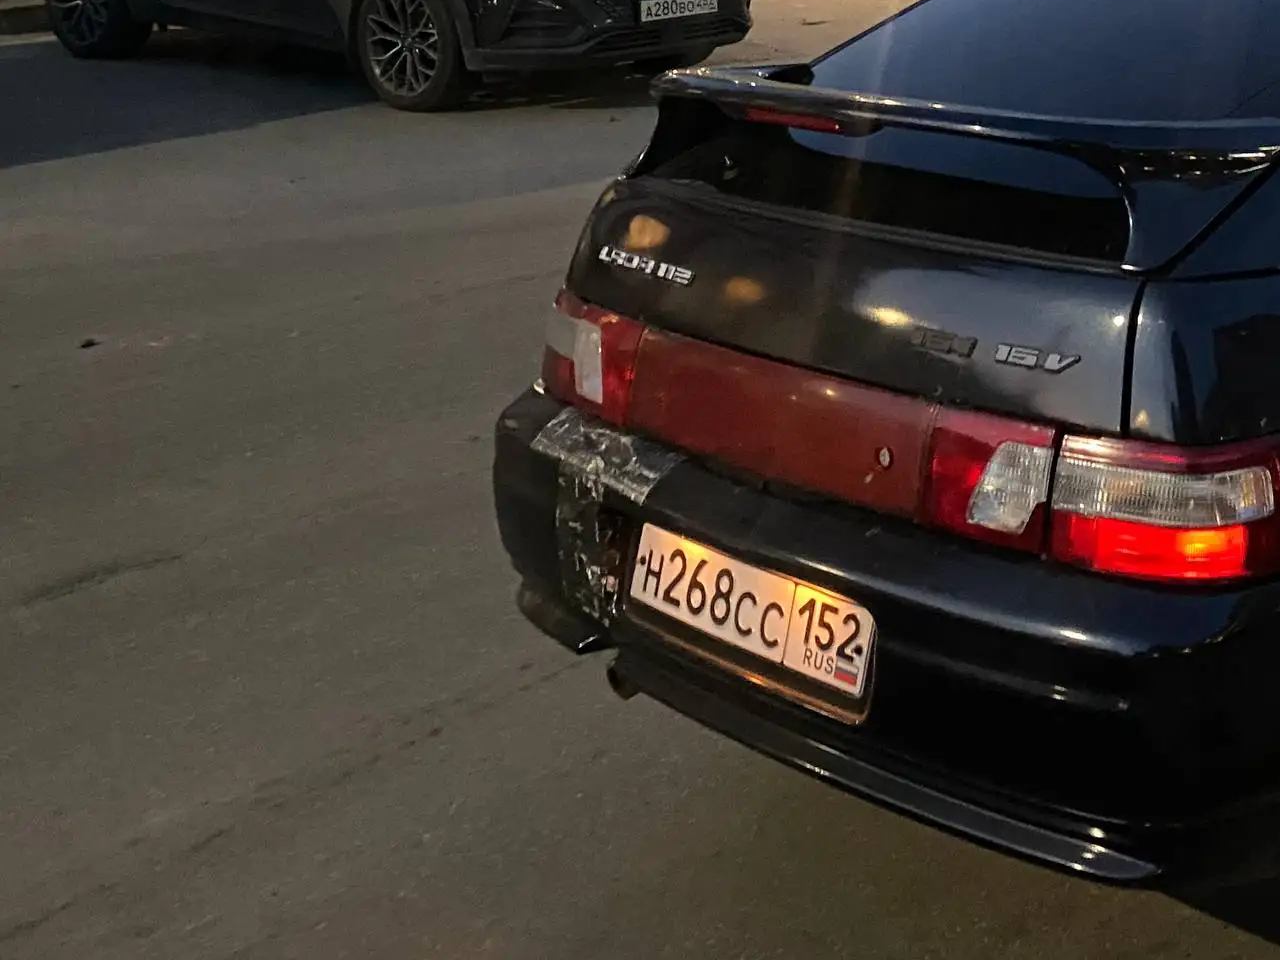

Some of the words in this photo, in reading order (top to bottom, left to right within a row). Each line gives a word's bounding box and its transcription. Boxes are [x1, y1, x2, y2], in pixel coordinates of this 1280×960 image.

[646, 0, 695, 17] А280ВО
[598, 245, 656, 275] LADA
[642, 548, 785, 649] Н268СС
[798, 597, 861, 663] 152
[802, 647, 834, 675] RUS
